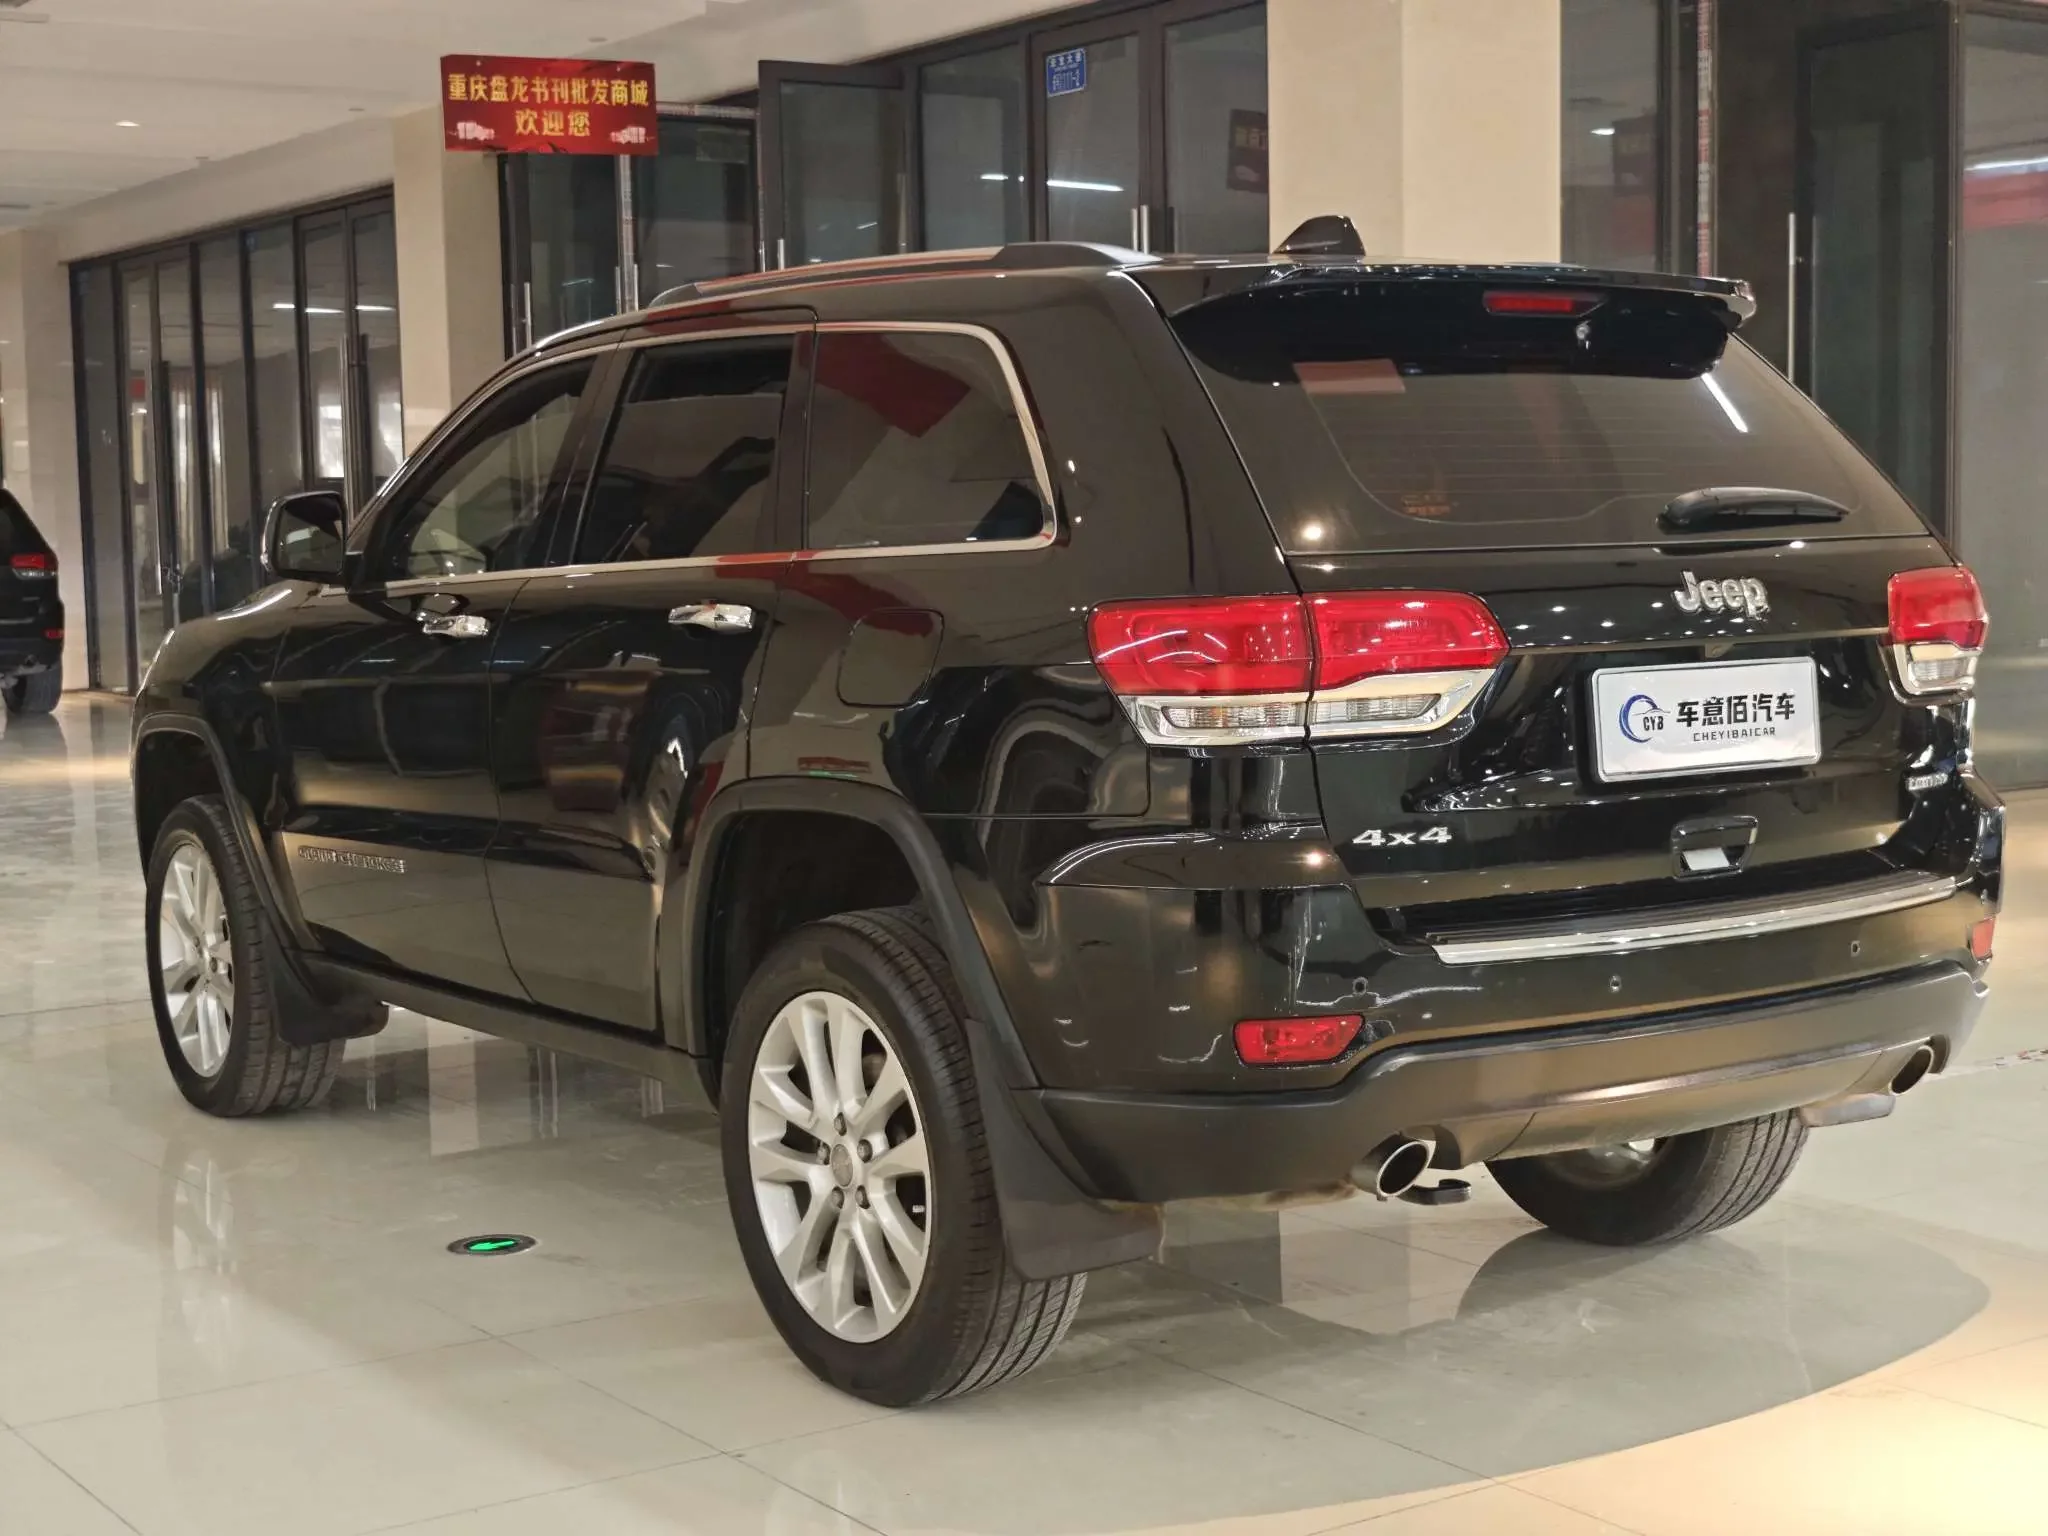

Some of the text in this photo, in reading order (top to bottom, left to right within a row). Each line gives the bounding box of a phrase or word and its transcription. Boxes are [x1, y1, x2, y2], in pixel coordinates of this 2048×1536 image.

[448, 74, 649, 106] 重庆盘龙书刊批发商城
[514, 108, 590, 137] 欢迎您
[1673, 570, 1769, 618] Jeep
[1643, 715, 1664, 731] CYB
[1676, 692, 1796, 727] 车意佰汽车
[1693, 727, 1776, 742] CHEYIBAICAR
[1352, 826, 1452, 846] 4x4
